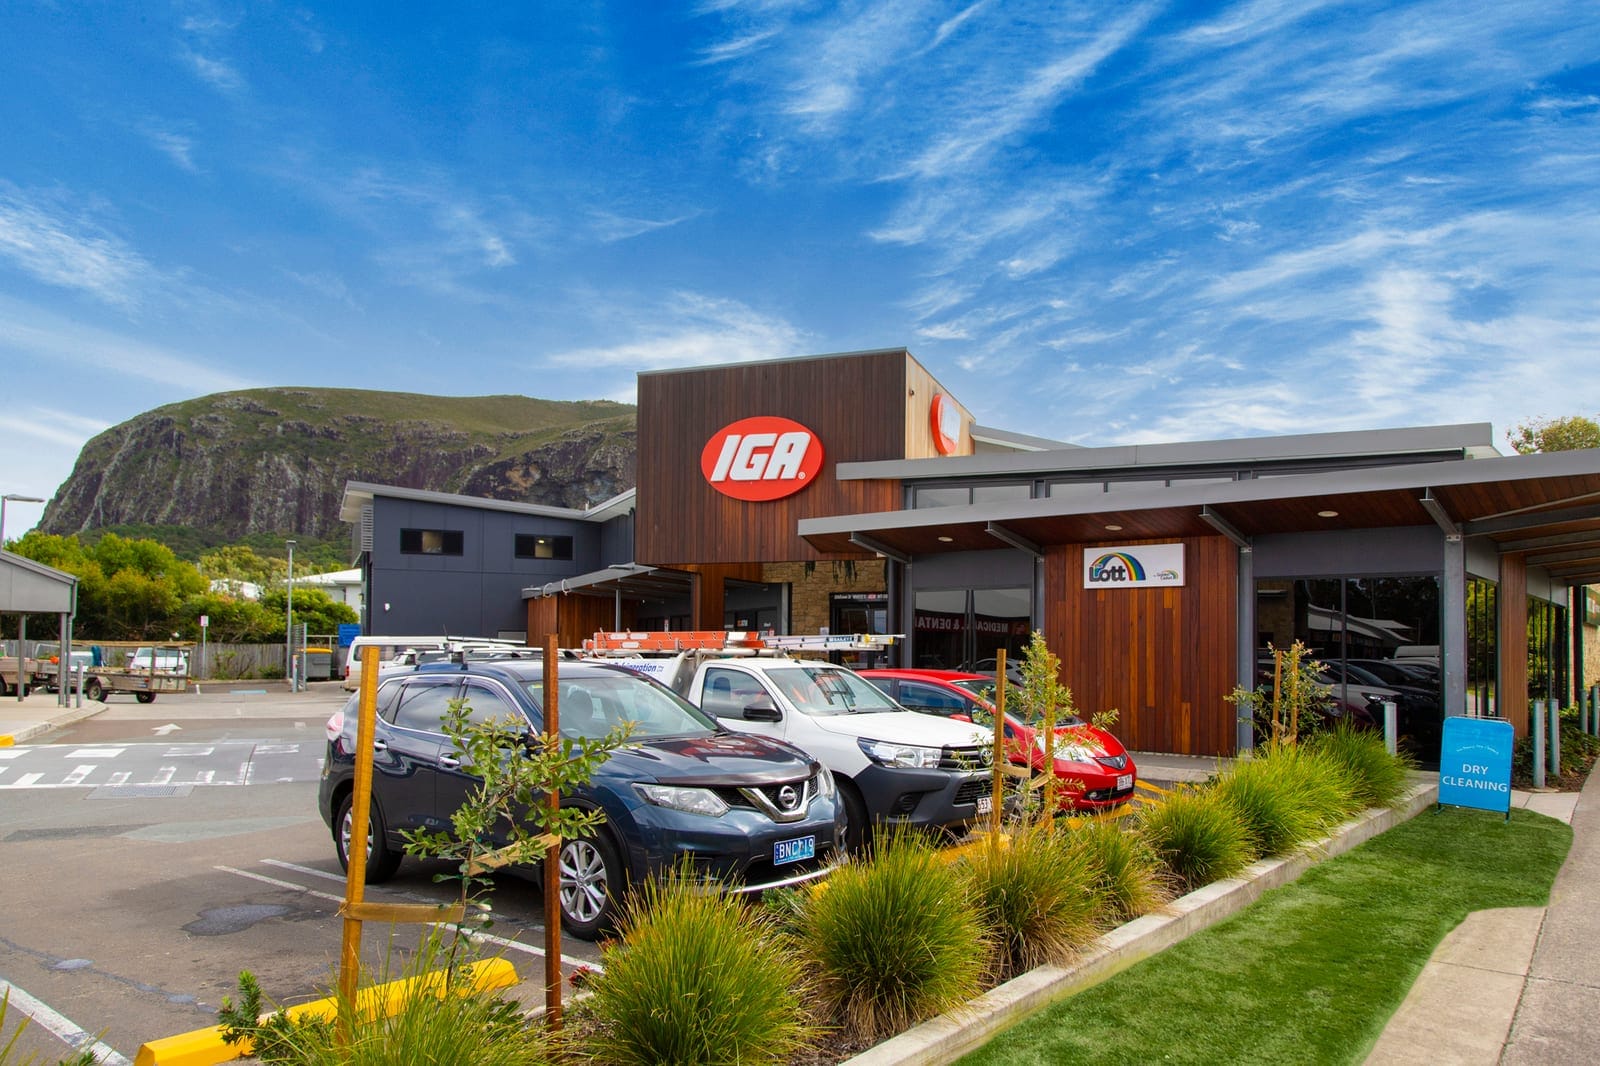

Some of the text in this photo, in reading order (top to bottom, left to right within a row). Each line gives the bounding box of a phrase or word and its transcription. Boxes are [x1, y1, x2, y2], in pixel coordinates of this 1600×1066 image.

[710, 432, 811, 481] IGA
[1462, 763, 1489, 775] DRY
[1442, 776, 1508, 793] CLEANING
